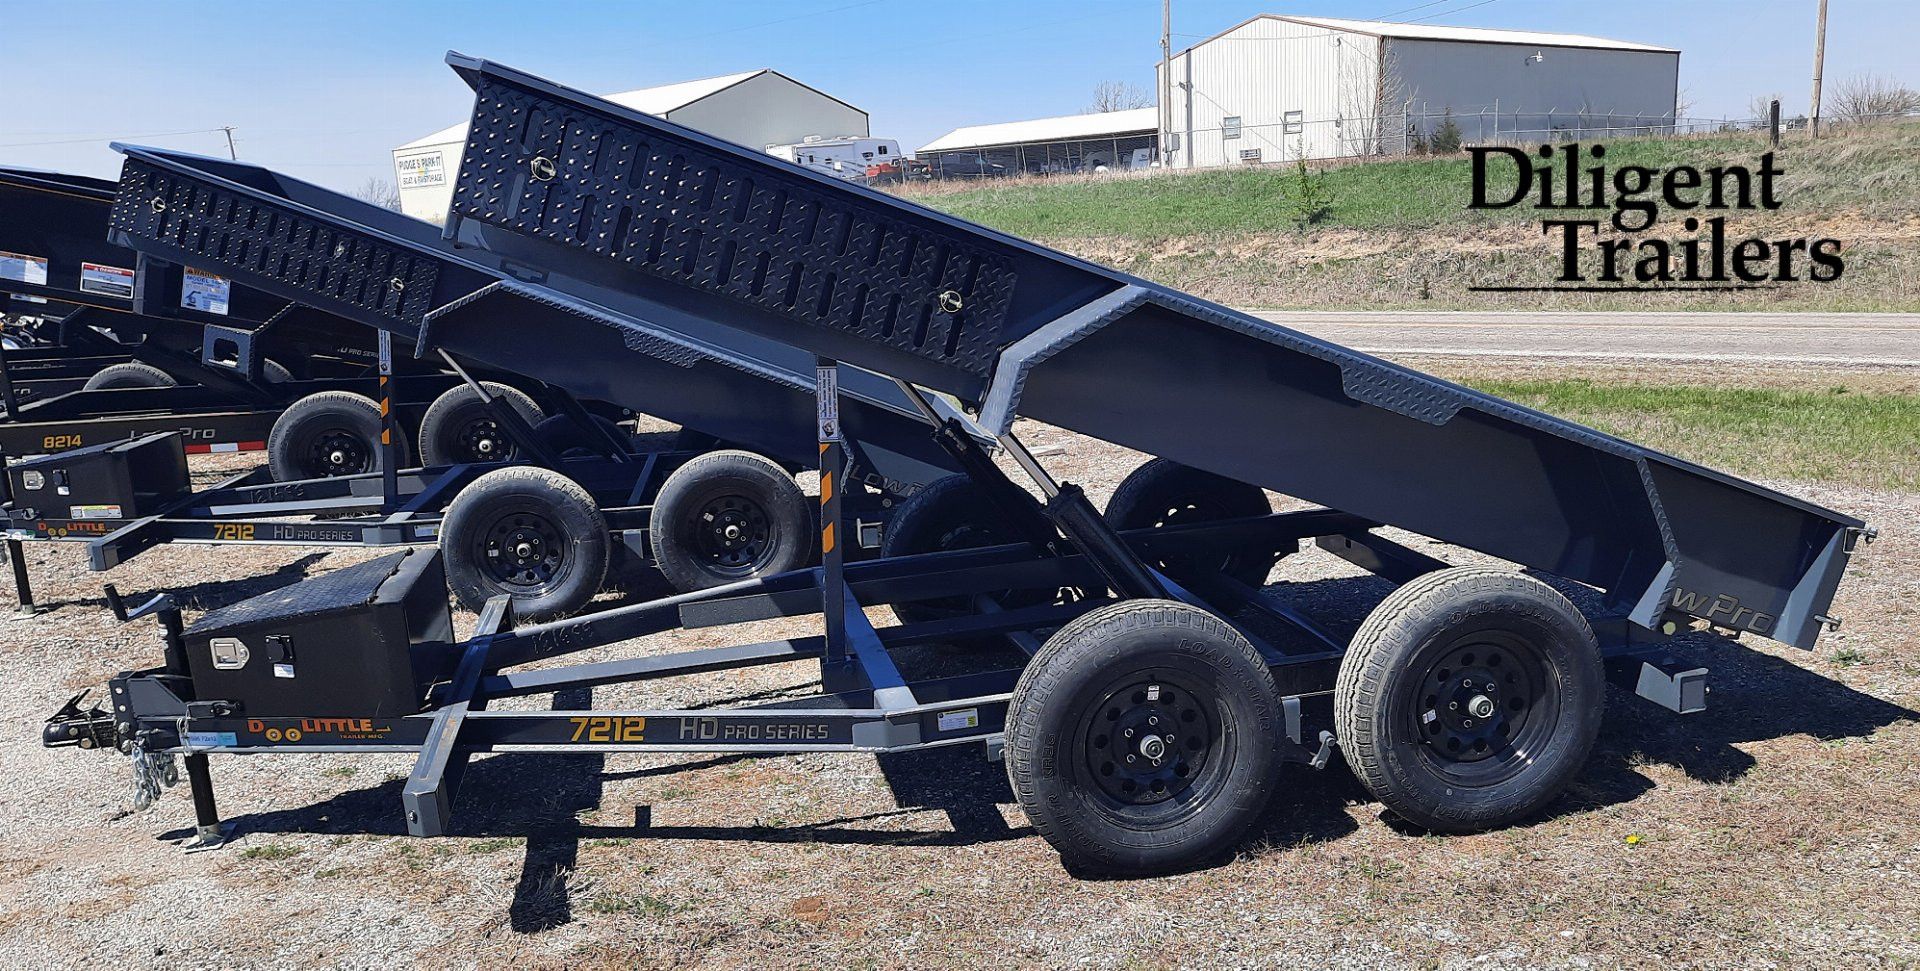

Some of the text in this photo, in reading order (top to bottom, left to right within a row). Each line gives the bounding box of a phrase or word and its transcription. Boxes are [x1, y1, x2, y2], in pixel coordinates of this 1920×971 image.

[43, 434, 82, 449] 8214
[213, 524, 353, 541] 7212 HD PRO SERIES
[569, 717, 829, 742] 7212 HD PRO SERIES
